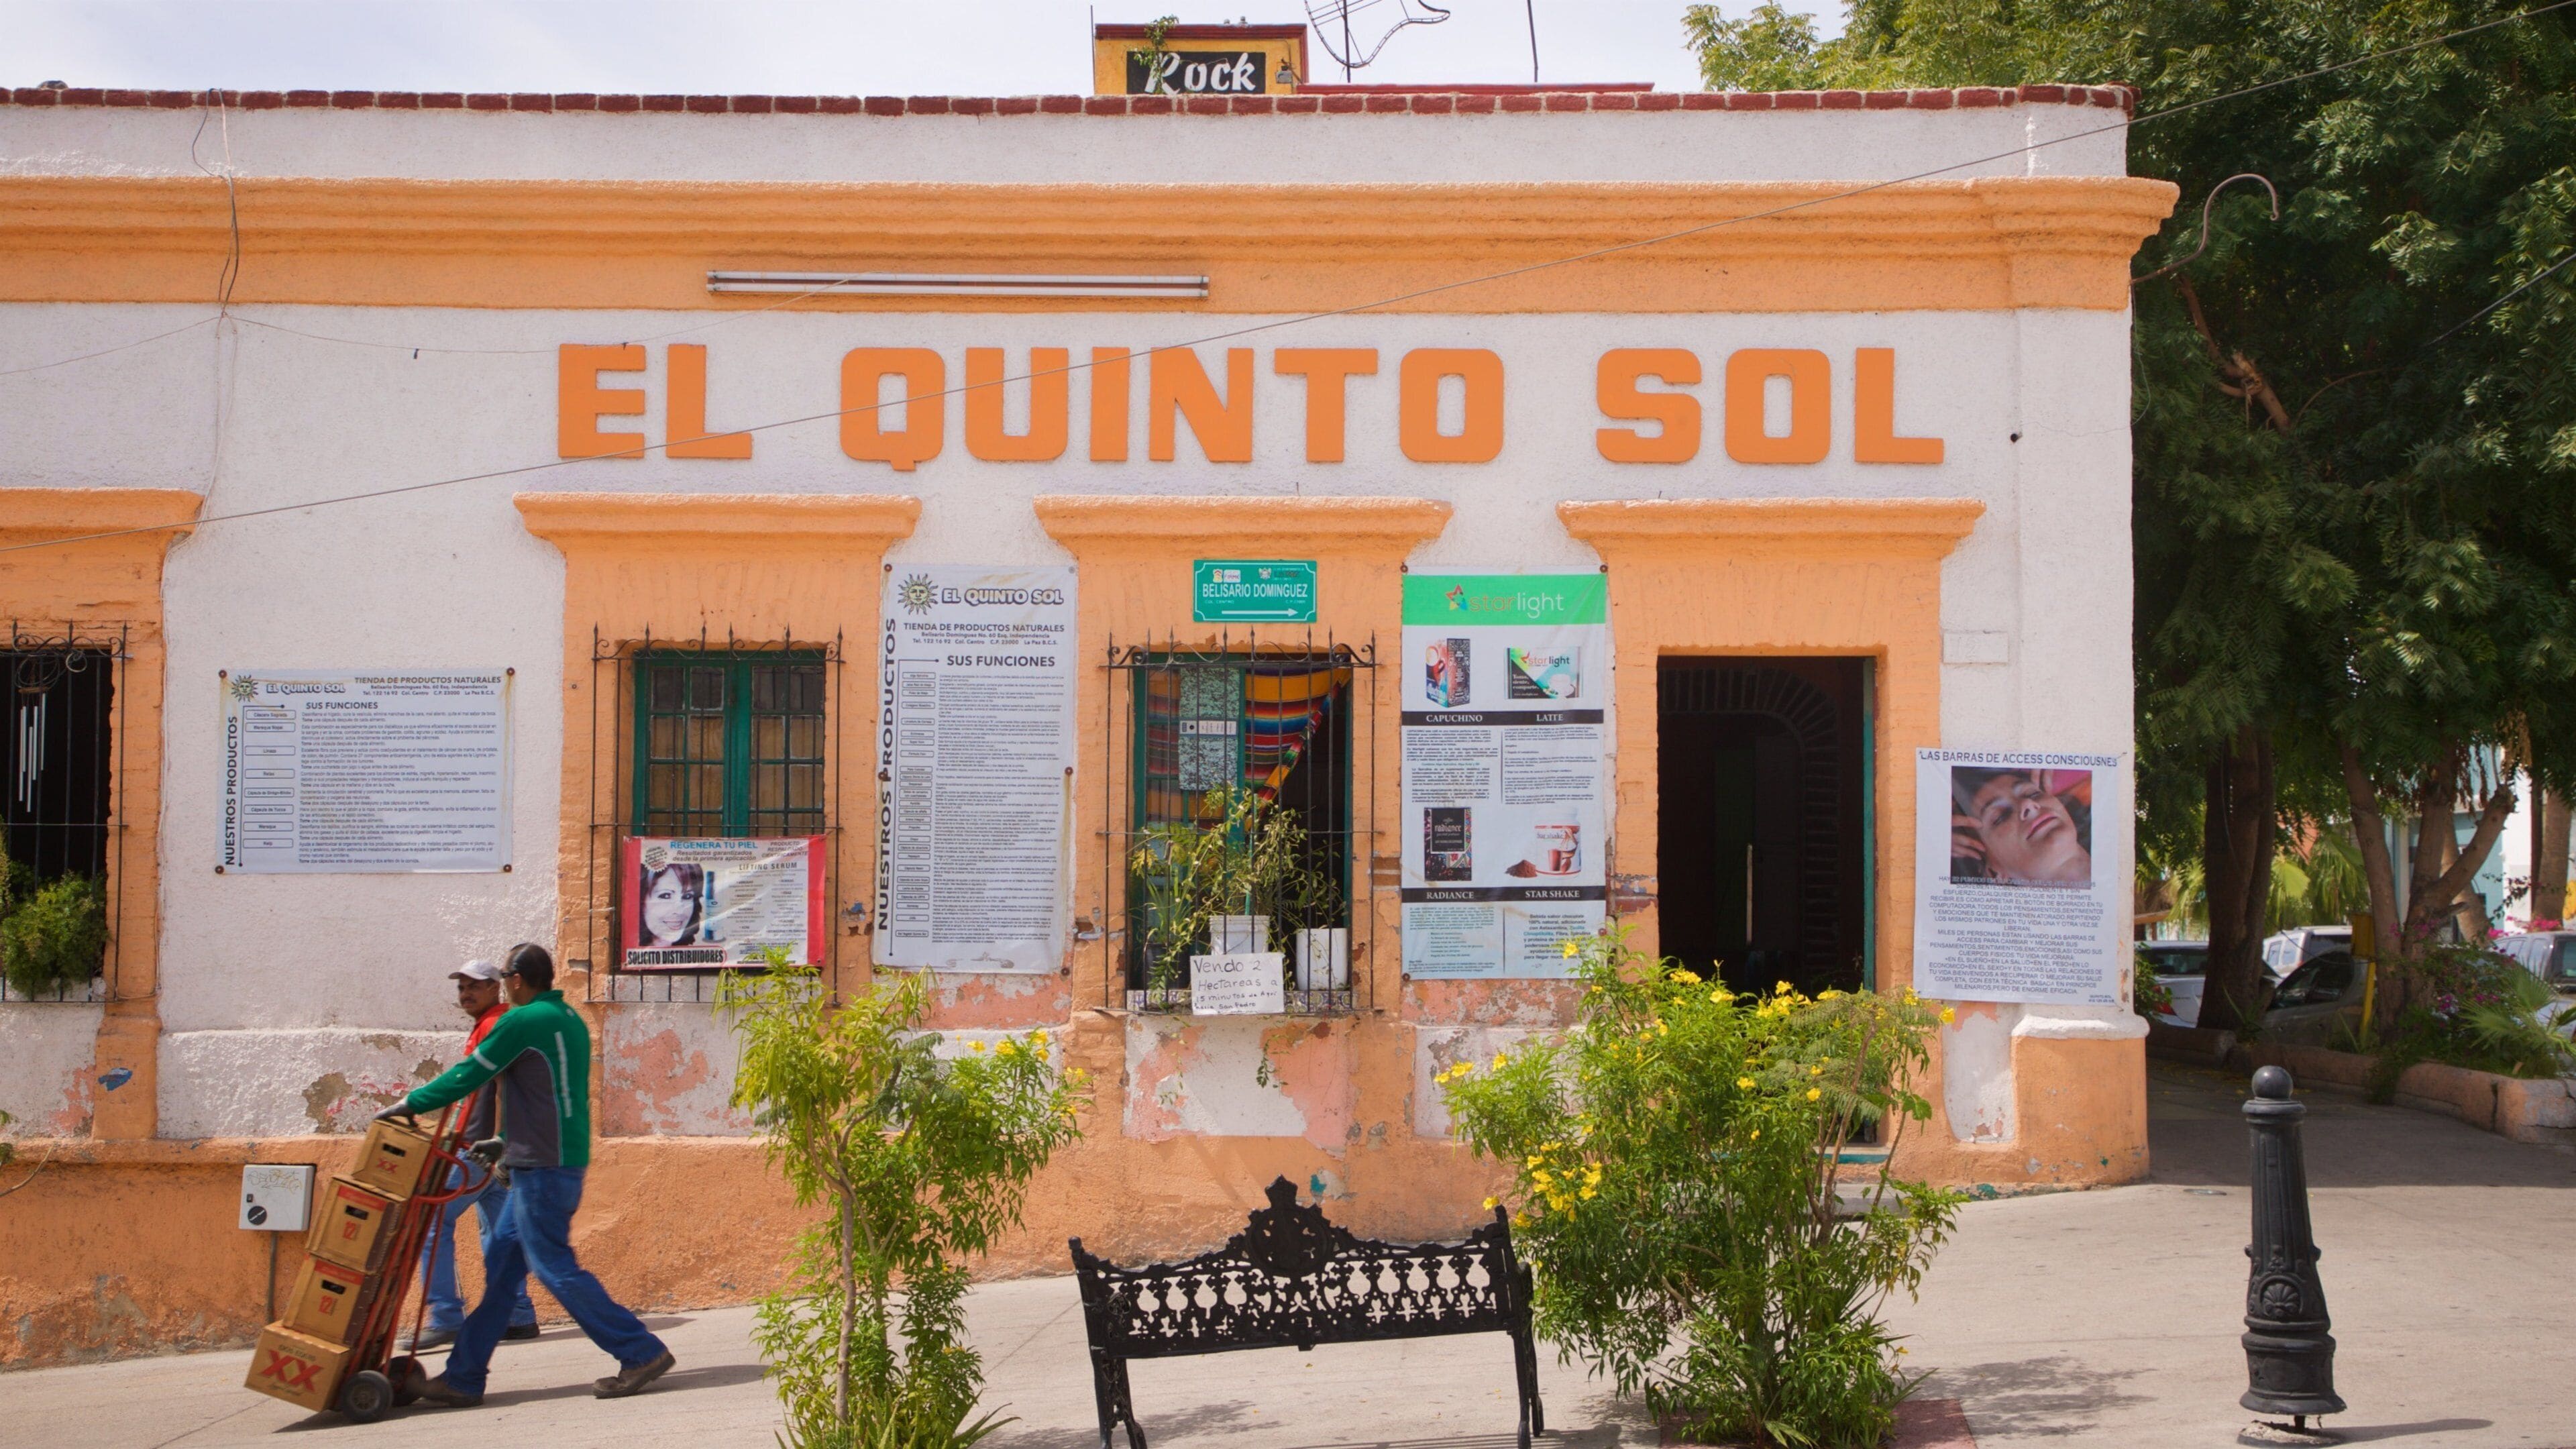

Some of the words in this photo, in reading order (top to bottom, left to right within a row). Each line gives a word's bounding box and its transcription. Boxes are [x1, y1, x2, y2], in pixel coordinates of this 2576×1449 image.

[1144, 52, 1255, 94] Rock
[559, 345, 751, 460] EL
[841, 347, 1503, 472] QUINTO
[1597, 349, 1943, 464] SOL
[942, 588, 961, 602] EL
[965, 589, 1028, 606] QUINTO
[1031, 590, 1064, 604] SOL
[1203, 584, 1250, 597] BELISARIO
[1254, 584, 1307, 597] DOMINGUEZ
[1470, 593, 1564, 619] starlight
[947, 656, 971, 666] SUS
[976, 656, 1055, 666] FUNCIONES
[1528, 655, 1570, 667] starlight
[266, 684, 279, 693] EL
[281, 684, 322, 694] QUINTO
[324, 684, 345, 693] SOL
[882, 619, 896, 782] PRODUCTOS
[1536, 714, 1563, 722] LATTE
[228, 716, 237, 795] PRODUCTOS
[1921, 752, 1939, 761] LAS
[1943, 753, 1983, 762] BARRAS
[1986, 754, 1998, 763] DE
[2002, 755, 2043, 764] ACCESS
[225, 798, 236, 865] NUESTROS
[879, 791, 892, 930] NUESTROS
[1525, 890, 1548, 898] STAR
[628, 951, 660, 964] SOLICITO
[663, 950, 723, 964] DISTRIBUIDORES
[1194, 958, 1244, 973] Vendo
[1253, 961, 1261, 971] 2
[1198, 978, 1261, 991] Hectareas
[377, 1158, 398, 1174] XX
[262, 1349, 324, 1392] XX
